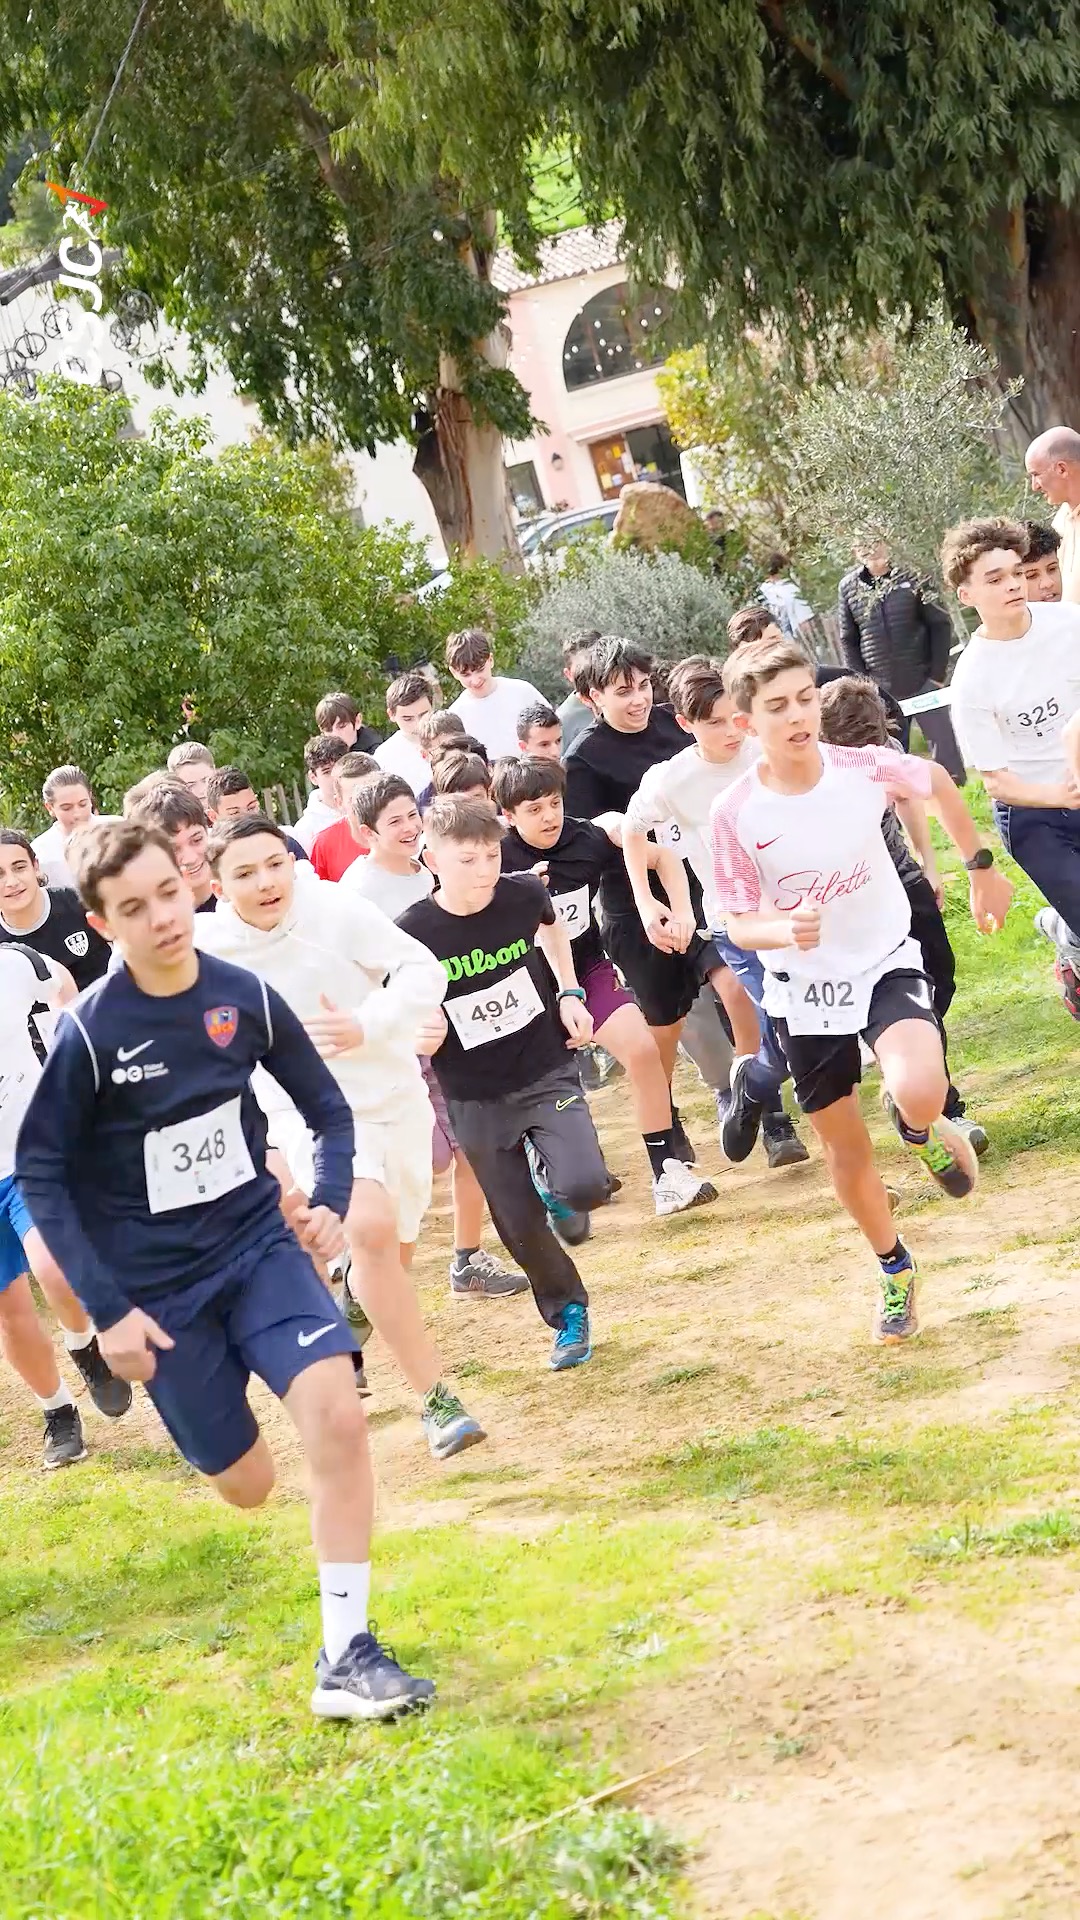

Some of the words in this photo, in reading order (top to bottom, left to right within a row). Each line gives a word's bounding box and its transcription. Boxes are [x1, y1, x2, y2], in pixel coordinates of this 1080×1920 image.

[1017, 697, 1060, 727] 325
[471, 989, 519, 1022] 494
[804, 981, 854, 1007] 402
[172, 1128, 226, 1172] 348
